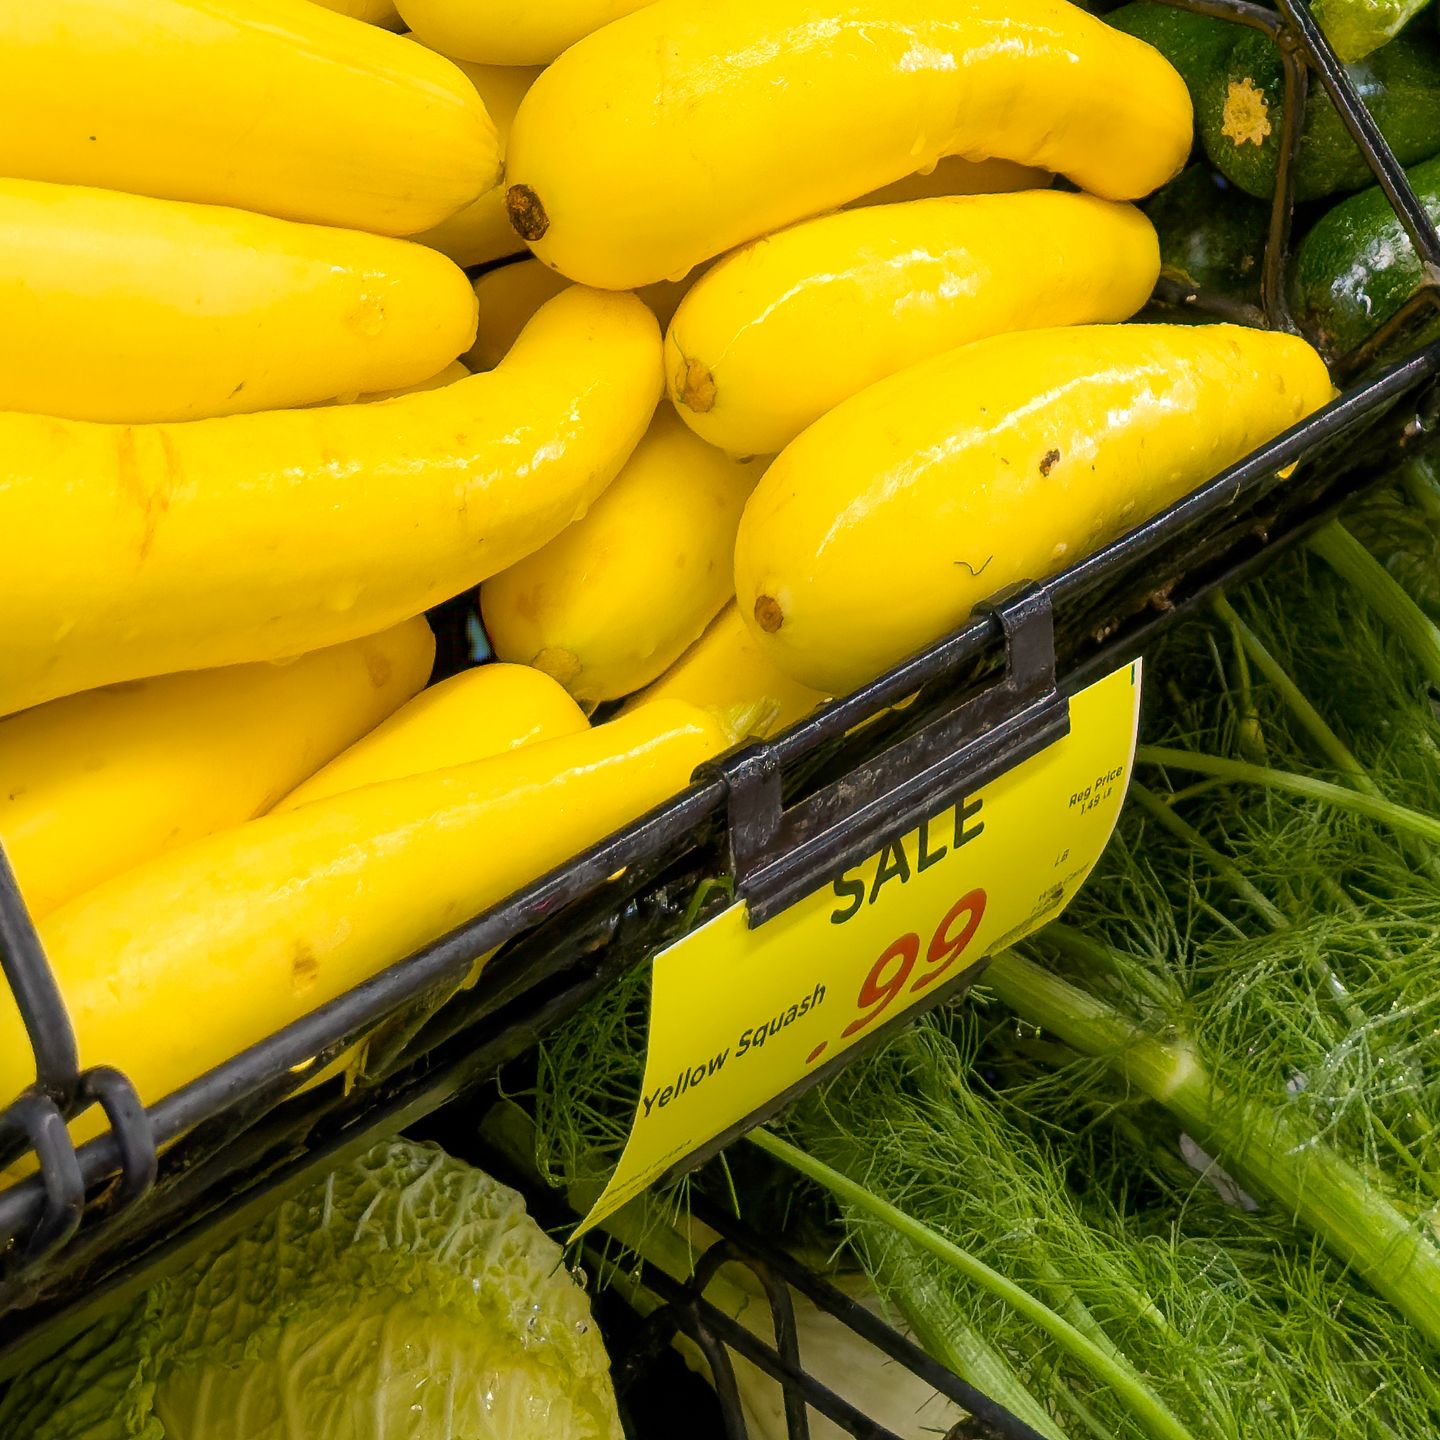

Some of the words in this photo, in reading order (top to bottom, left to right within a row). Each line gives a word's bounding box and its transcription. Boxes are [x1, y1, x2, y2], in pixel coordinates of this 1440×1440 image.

[1068, 786, 1092, 809] Reg
[1093, 766, 1124, 792] Price
[829, 796, 986, 926] SALE
[641, 1046, 730, 1118] Yellow
[734, 982, 827, 1060] Squash
